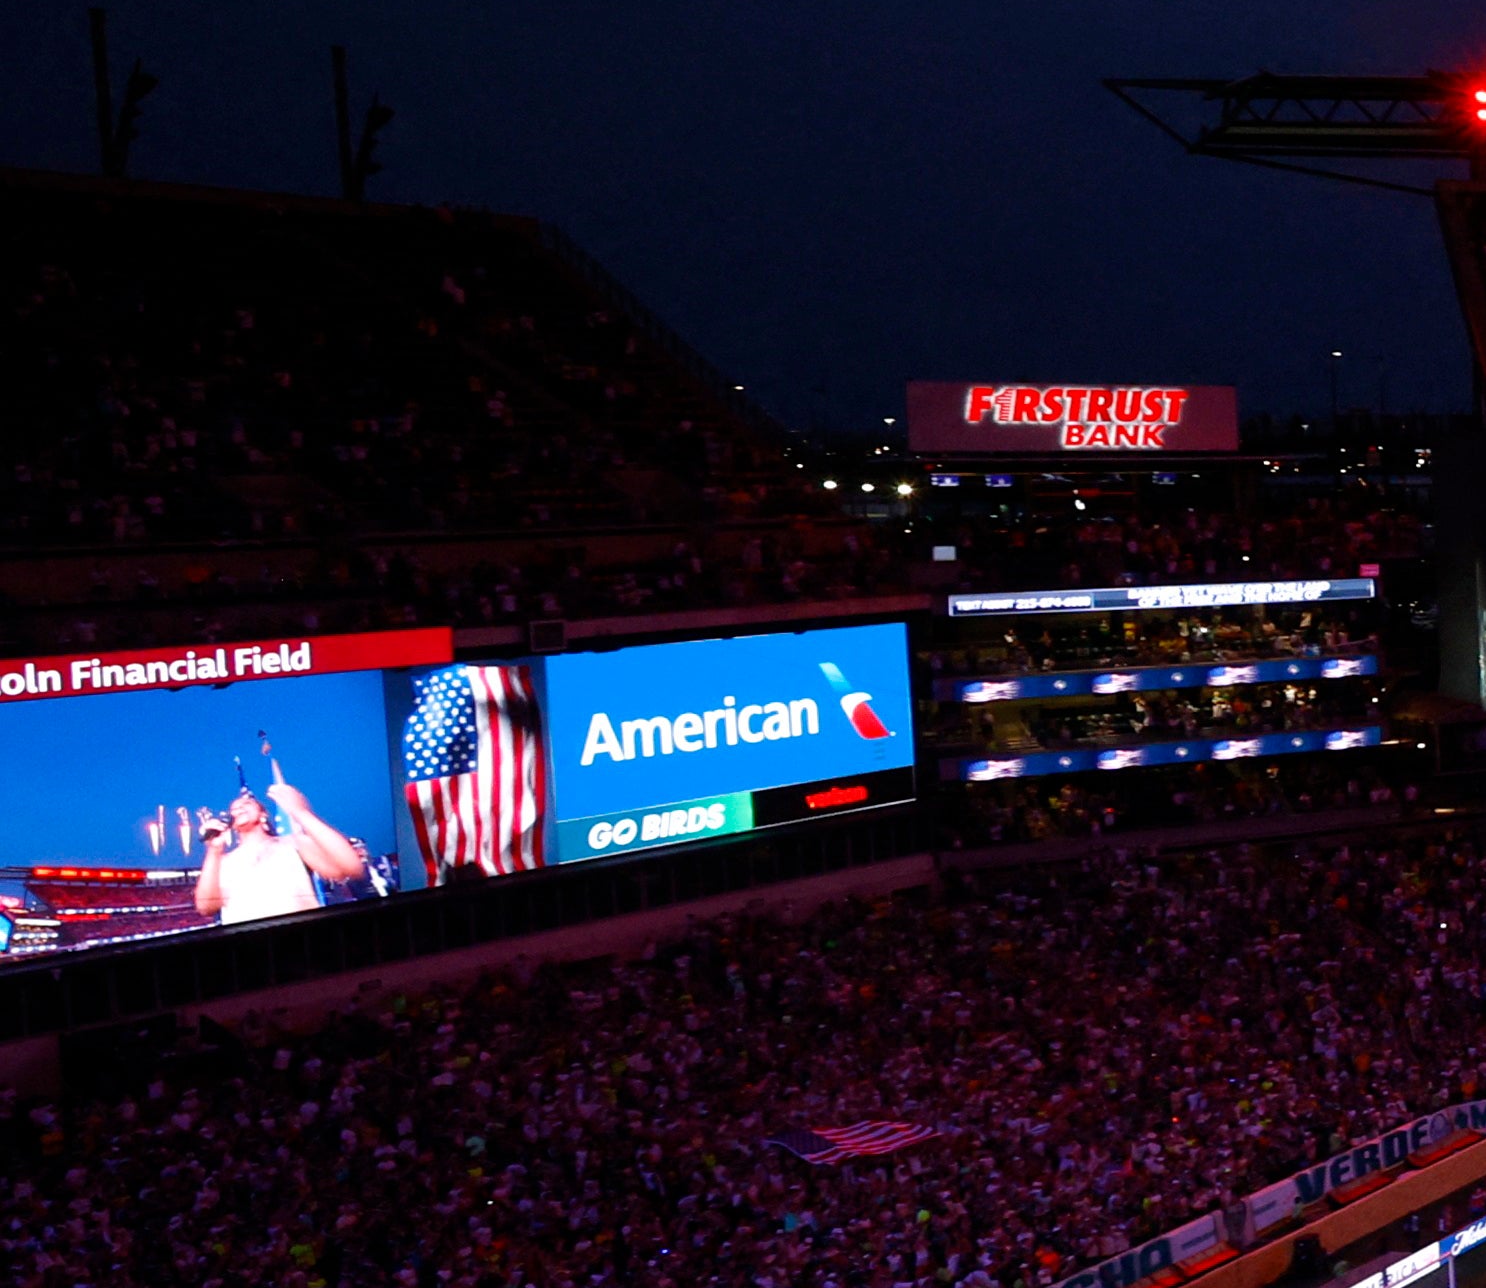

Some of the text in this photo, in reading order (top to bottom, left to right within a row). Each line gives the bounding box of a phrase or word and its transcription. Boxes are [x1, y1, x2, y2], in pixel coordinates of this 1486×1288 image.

[1063, 424, 1165, 449] BANK
[0, 642, 311, 695] oln Financial Field
[580, 695, 819, 766] American
[588, 803, 726, 849] GO BIRDS
[1295, 1118, 1428, 1205] VERDE
